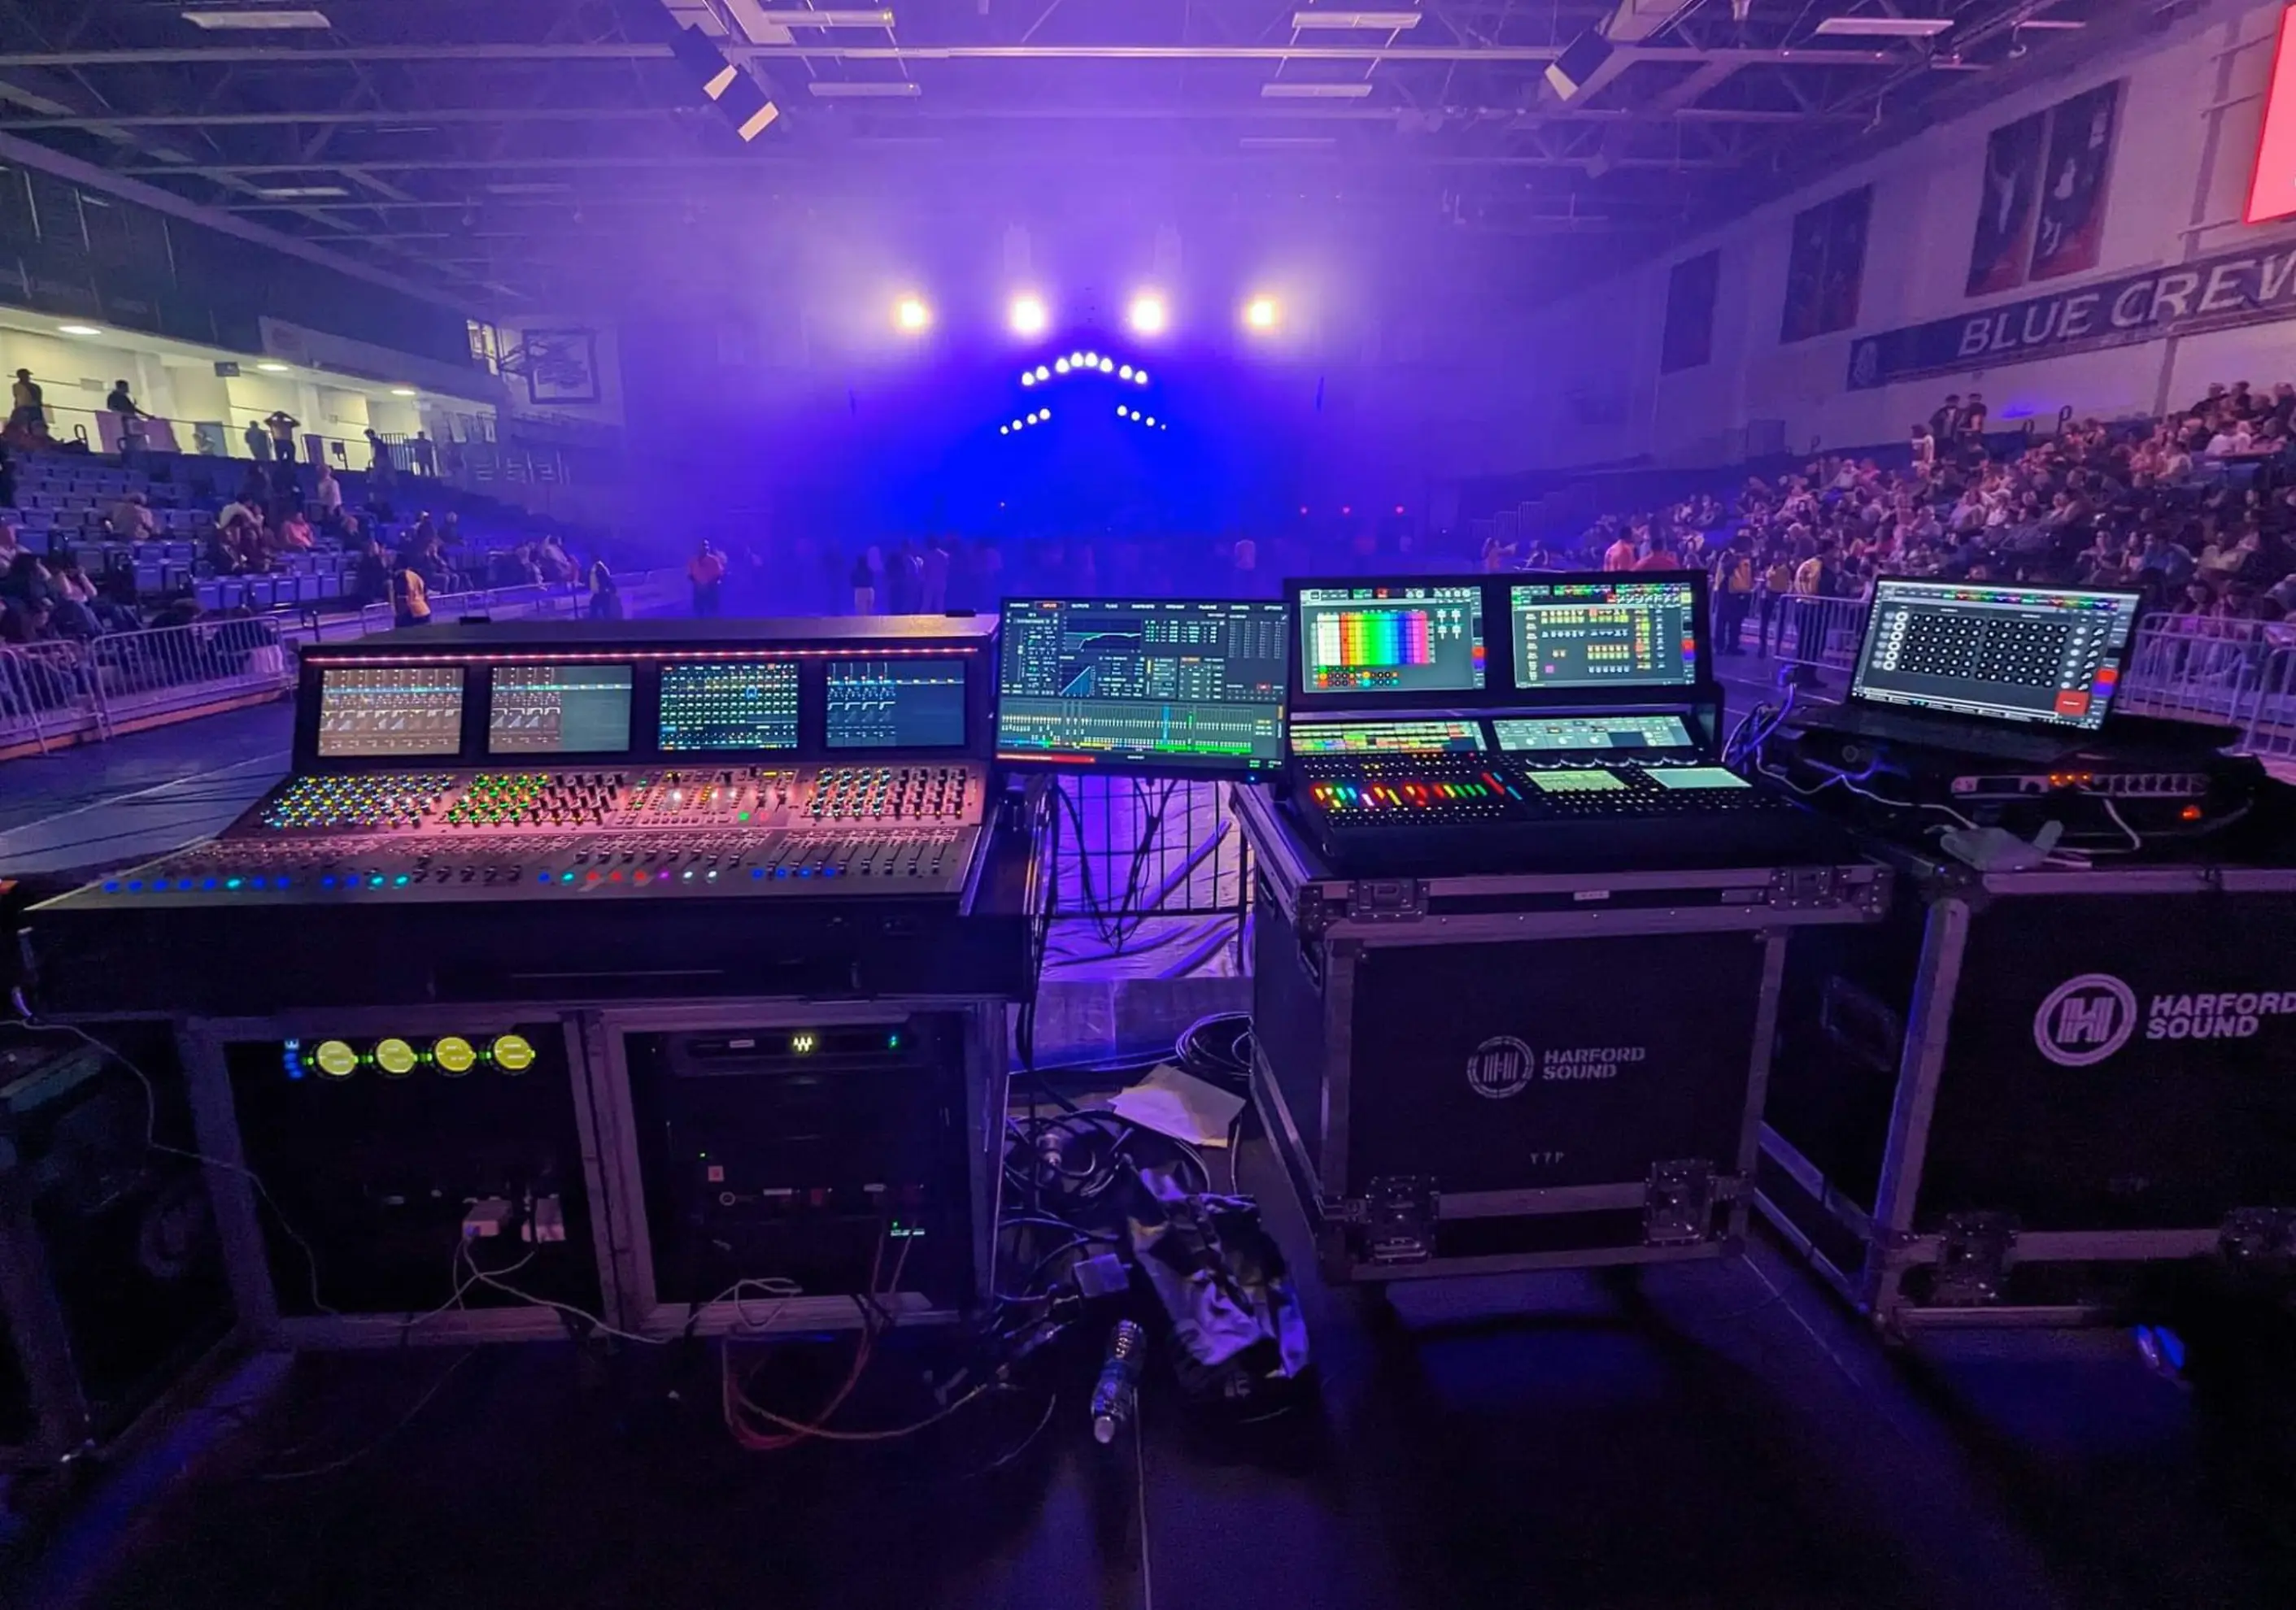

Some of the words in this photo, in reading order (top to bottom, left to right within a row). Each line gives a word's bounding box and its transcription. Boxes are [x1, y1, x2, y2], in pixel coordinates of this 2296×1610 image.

[1958, 294, 2099, 357] BLUE
[2150, 992, 2296, 1016] HARFORD
[2146, 1016, 2259, 1039] SOUND
[1544, 1046, 1646, 1064] HARFORD
[1542, 1063, 1617, 1081] SOUND
